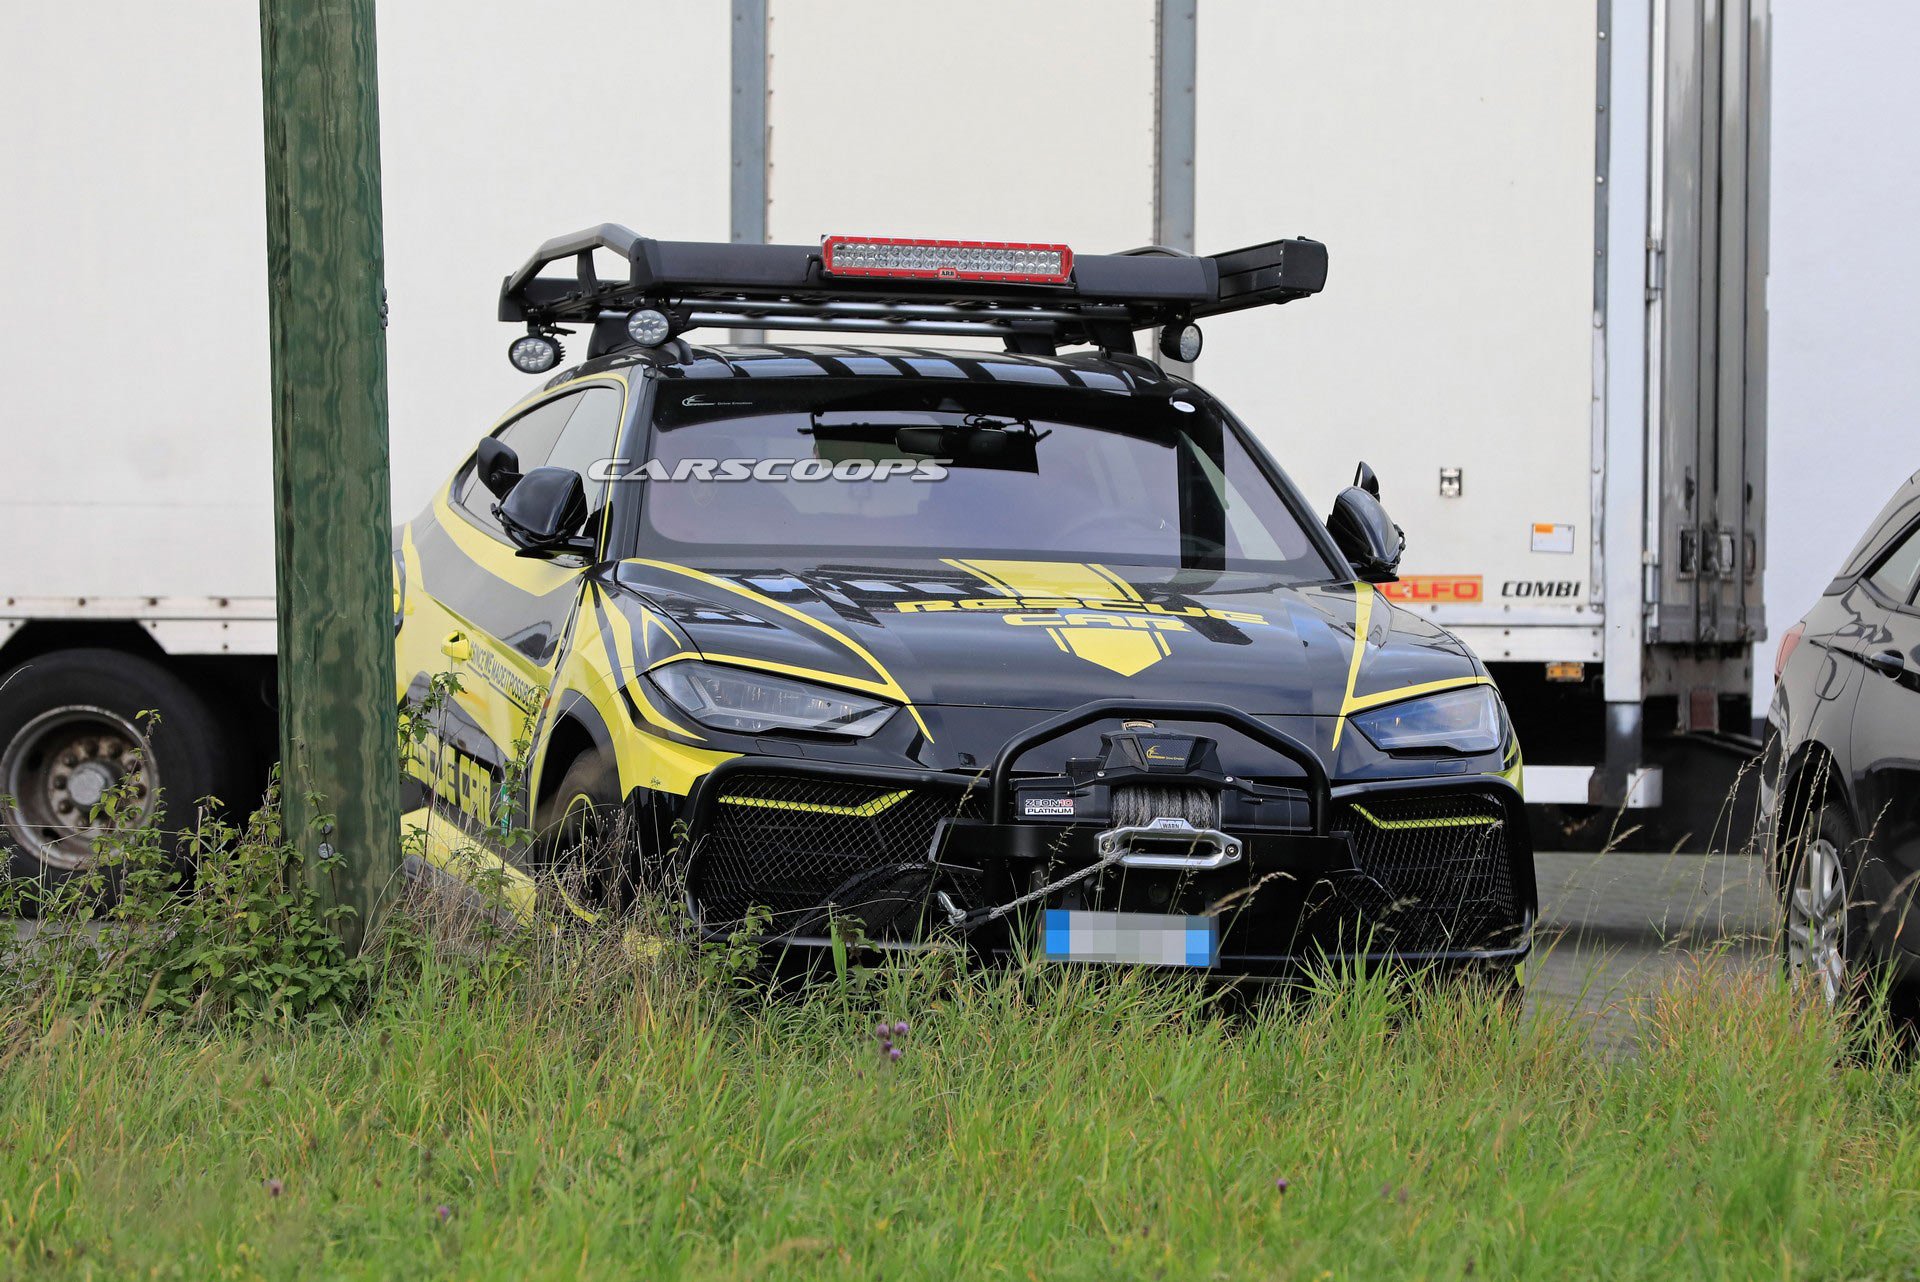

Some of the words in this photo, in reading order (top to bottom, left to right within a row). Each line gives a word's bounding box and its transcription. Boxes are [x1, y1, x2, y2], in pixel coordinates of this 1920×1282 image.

[1376, 581, 1479, 599] OLFO
[1501, 580, 1581, 598] COMBI
[894, 598, 1270, 625] RESCUE
[1002, 613, 1192, 633] CAR
[459, 753, 492, 828] CAR
